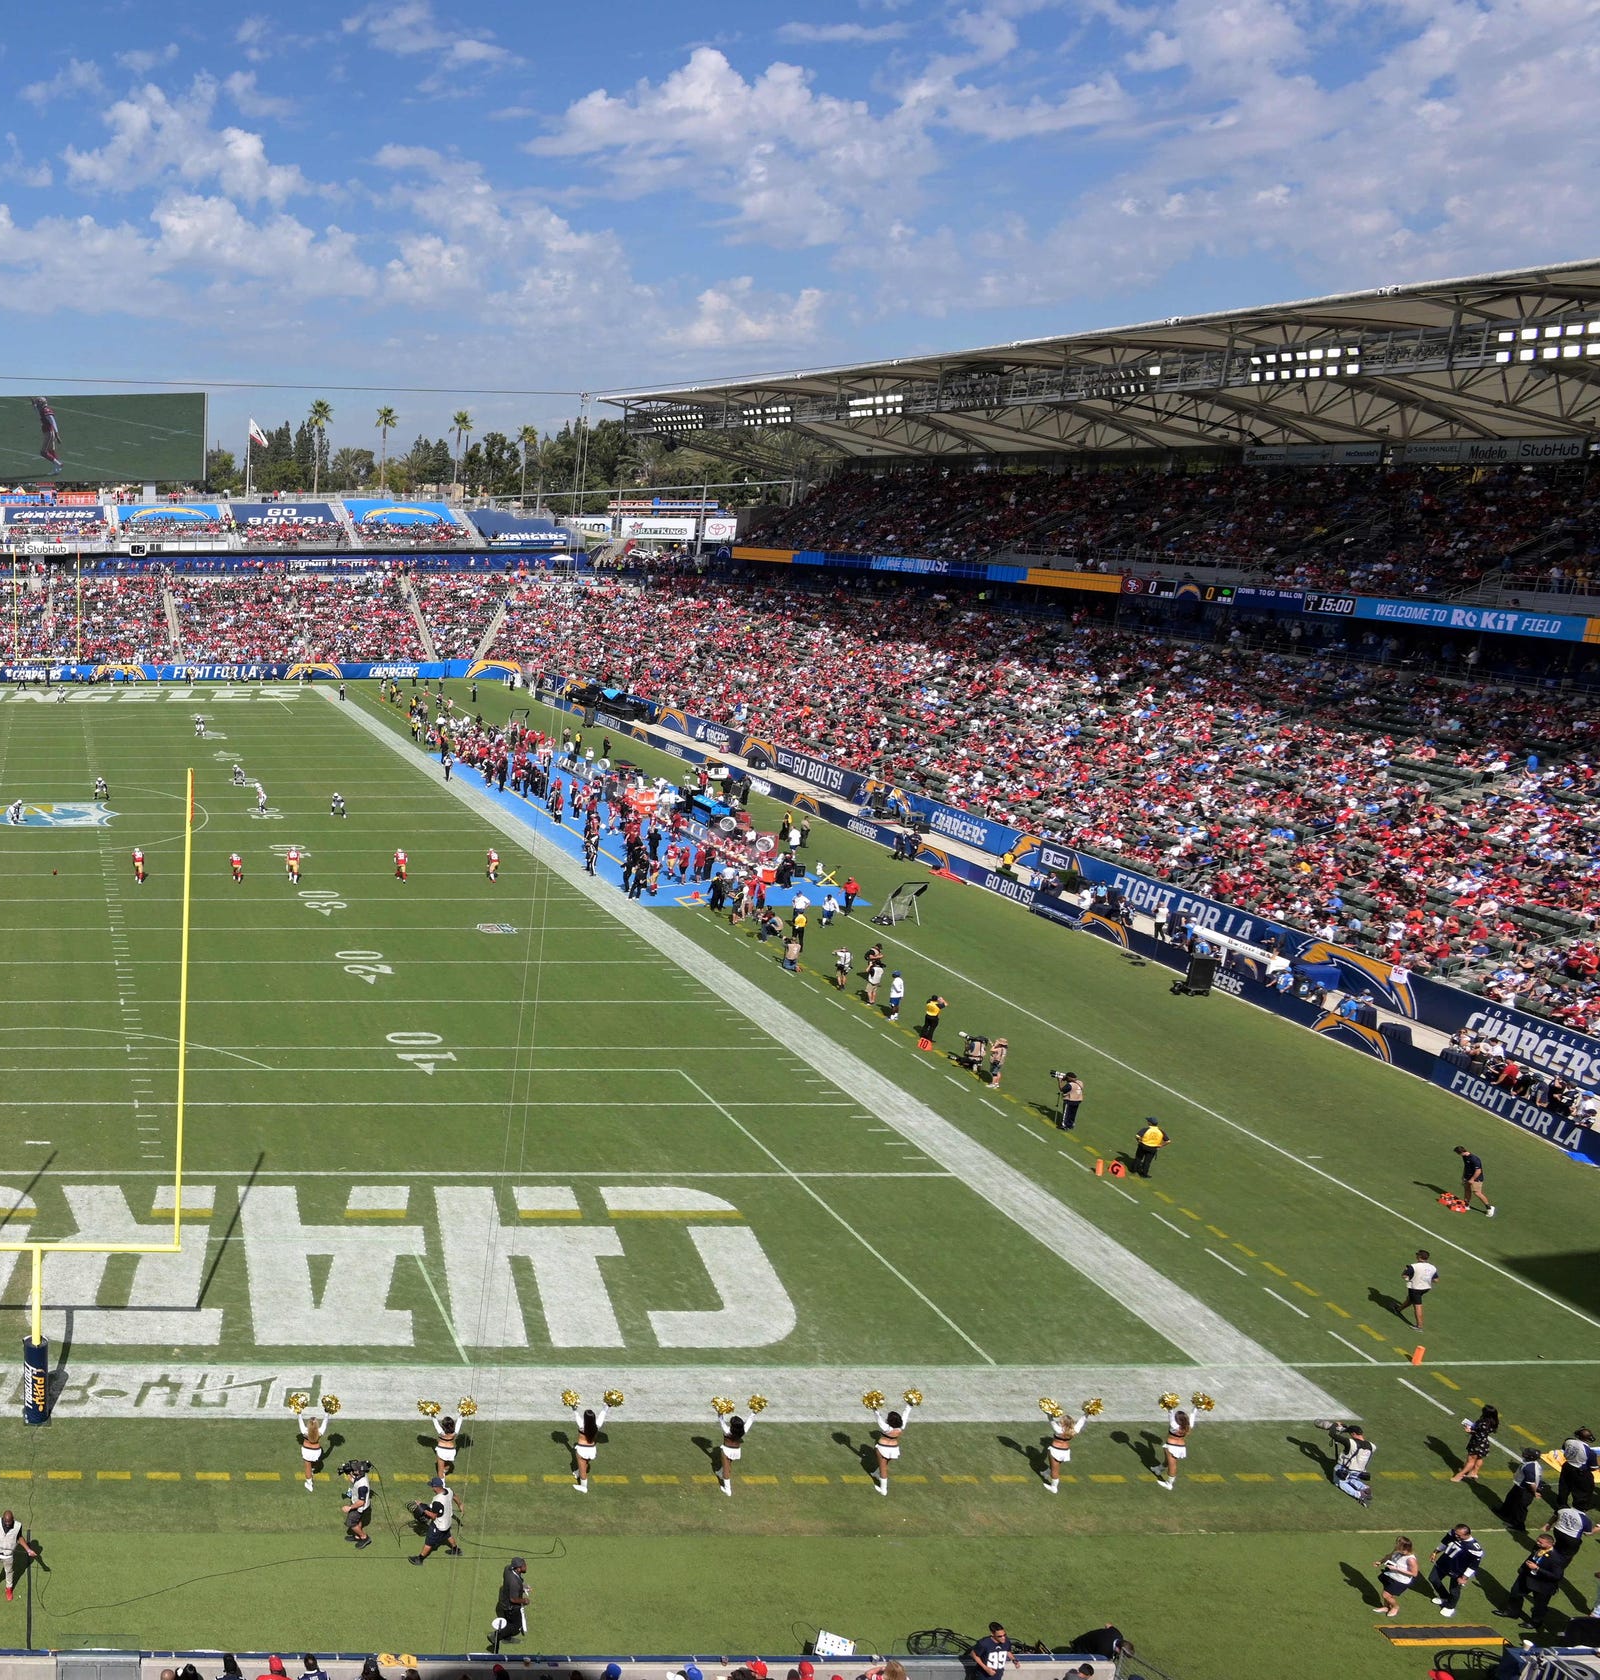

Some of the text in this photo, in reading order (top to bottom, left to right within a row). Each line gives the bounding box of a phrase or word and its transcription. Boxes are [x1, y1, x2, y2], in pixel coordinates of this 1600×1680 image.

[1468, 446, 1508, 460] Modelo
[1521, 444, 1579, 458] StubHub
[267, 508, 297, 516] GO
[634, 527, 687, 536] DRAFTKINGS
[27, 545, 67, 555] StubHub
[1148, 581, 1157, 594] 0
[1205, 586, 1215, 600] 0
[1318, 599, 1354, 613] 15:00
[1376, 603, 1430, 619] WELCOME
[1432, 608, 1447, 622] TO
[1521, 618, 1561, 634] FIELD
[793, 756, 807, 776] GO
[807, 761, 844, 790] BOLTS!
[847, 819, 878, 839] CHARGERS
[930, 811, 988, 846] CHARGERS
[1053, 856, 1066, 867] NFL
[985, 873, 1035, 905] GO BOLTS!
[298, 890, 347, 909] 30
[1113, 873, 1177, 914] FIGHT
[1177, 896, 1220, 934] FOR
[335, 951, 396, 975] 20
[1485, 1007, 1599, 1056] LOS ANGELES
[386, 1032, 457, 1061] 10
[1465, 1011, 1600, 1086] CHARGERS
[1450, 1070, 1583, 1151] FIGHT FOR LA
[1111, 1163, 1122, 1176] G
[24, 1361, 37, 1409] FOOTBALL
[1445, 1542, 1461, 1559] 17
[987, 1651, 1007, 1670] 99
